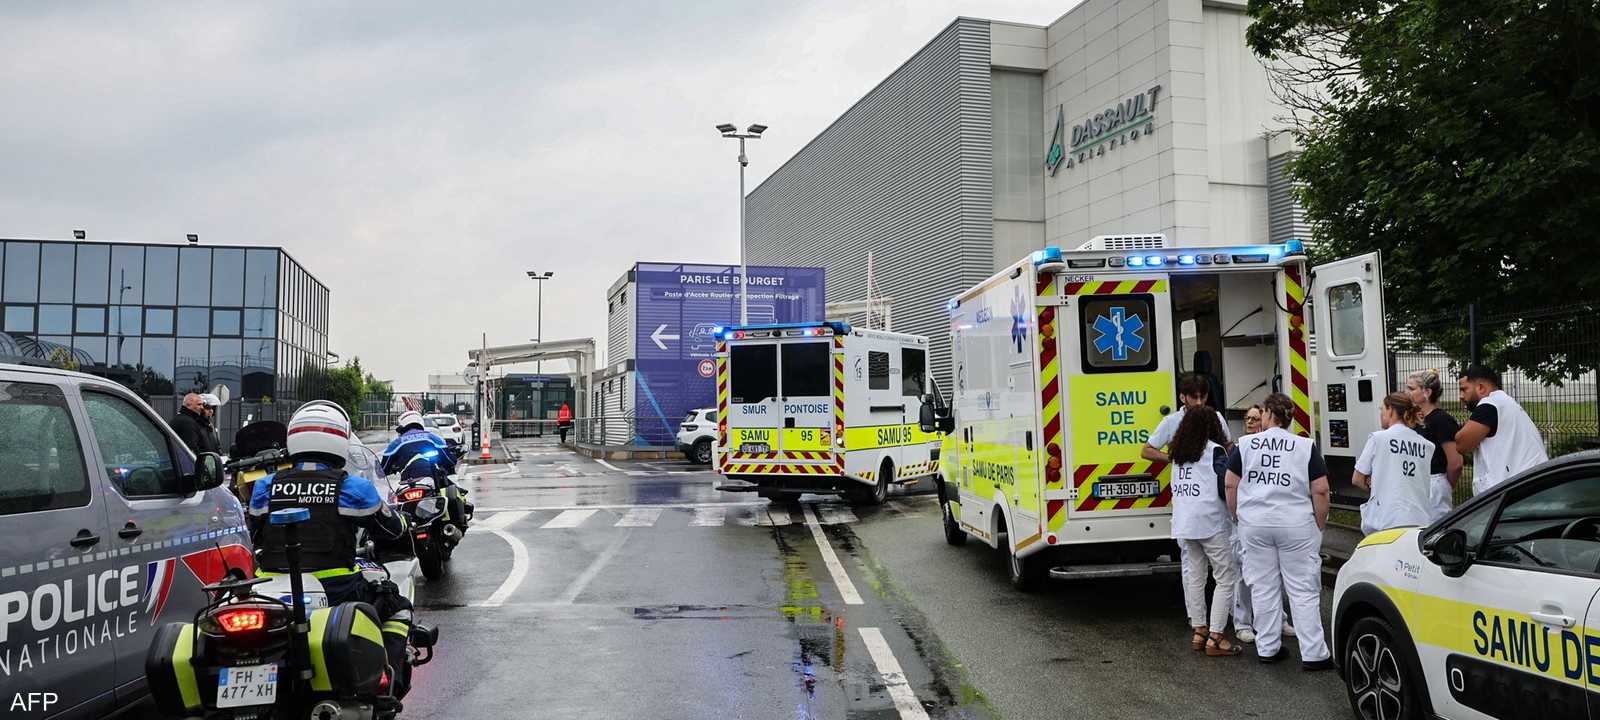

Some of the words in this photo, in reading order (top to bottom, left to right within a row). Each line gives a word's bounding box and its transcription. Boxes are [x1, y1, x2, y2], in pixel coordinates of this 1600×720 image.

[1071, 84, 1161, 148] DASSAULT
[1066, 121, 1153, 169] AVIATION
[1096, 390, 1146, 406] SAMU
[742, 405, 767, 415] SMUR
[784, 404, 829, 414] PONTOISE
[1111, 410, 1135, 425] DE
[740, 430, 770, 441] SAMU
[801, 430, 813, 441] 95
[877, 427, 901, 445] SAMU
[903, 427, 912, 442] 95
[1098, 429, 1149, 445] PARIS
[1251, 437, 1295, 452] SAMU
[1390, 439, 1426, 458] SAMU
[1261, 454, 1281, 468] DE
[1402, 460, 1416, 477] 92
[973, 459, 988, 479] SAMU
[987, 461, 996, 481] DE
[996, 463, 1015, 486] PARIS
[1179, 467, 1192, 479] DE
[1248, 470, 1291, 487] PARIS
[271, 483, 337, 496] POLICE
[0, 565, 139, 643] POLICE
[0, 611, 137, 676] NATIONALE
[1472, 610, 1551, 673] SAMU
[1561, 629, 1600, 686] DE
[221, 683, 273, 699] 477-XH
